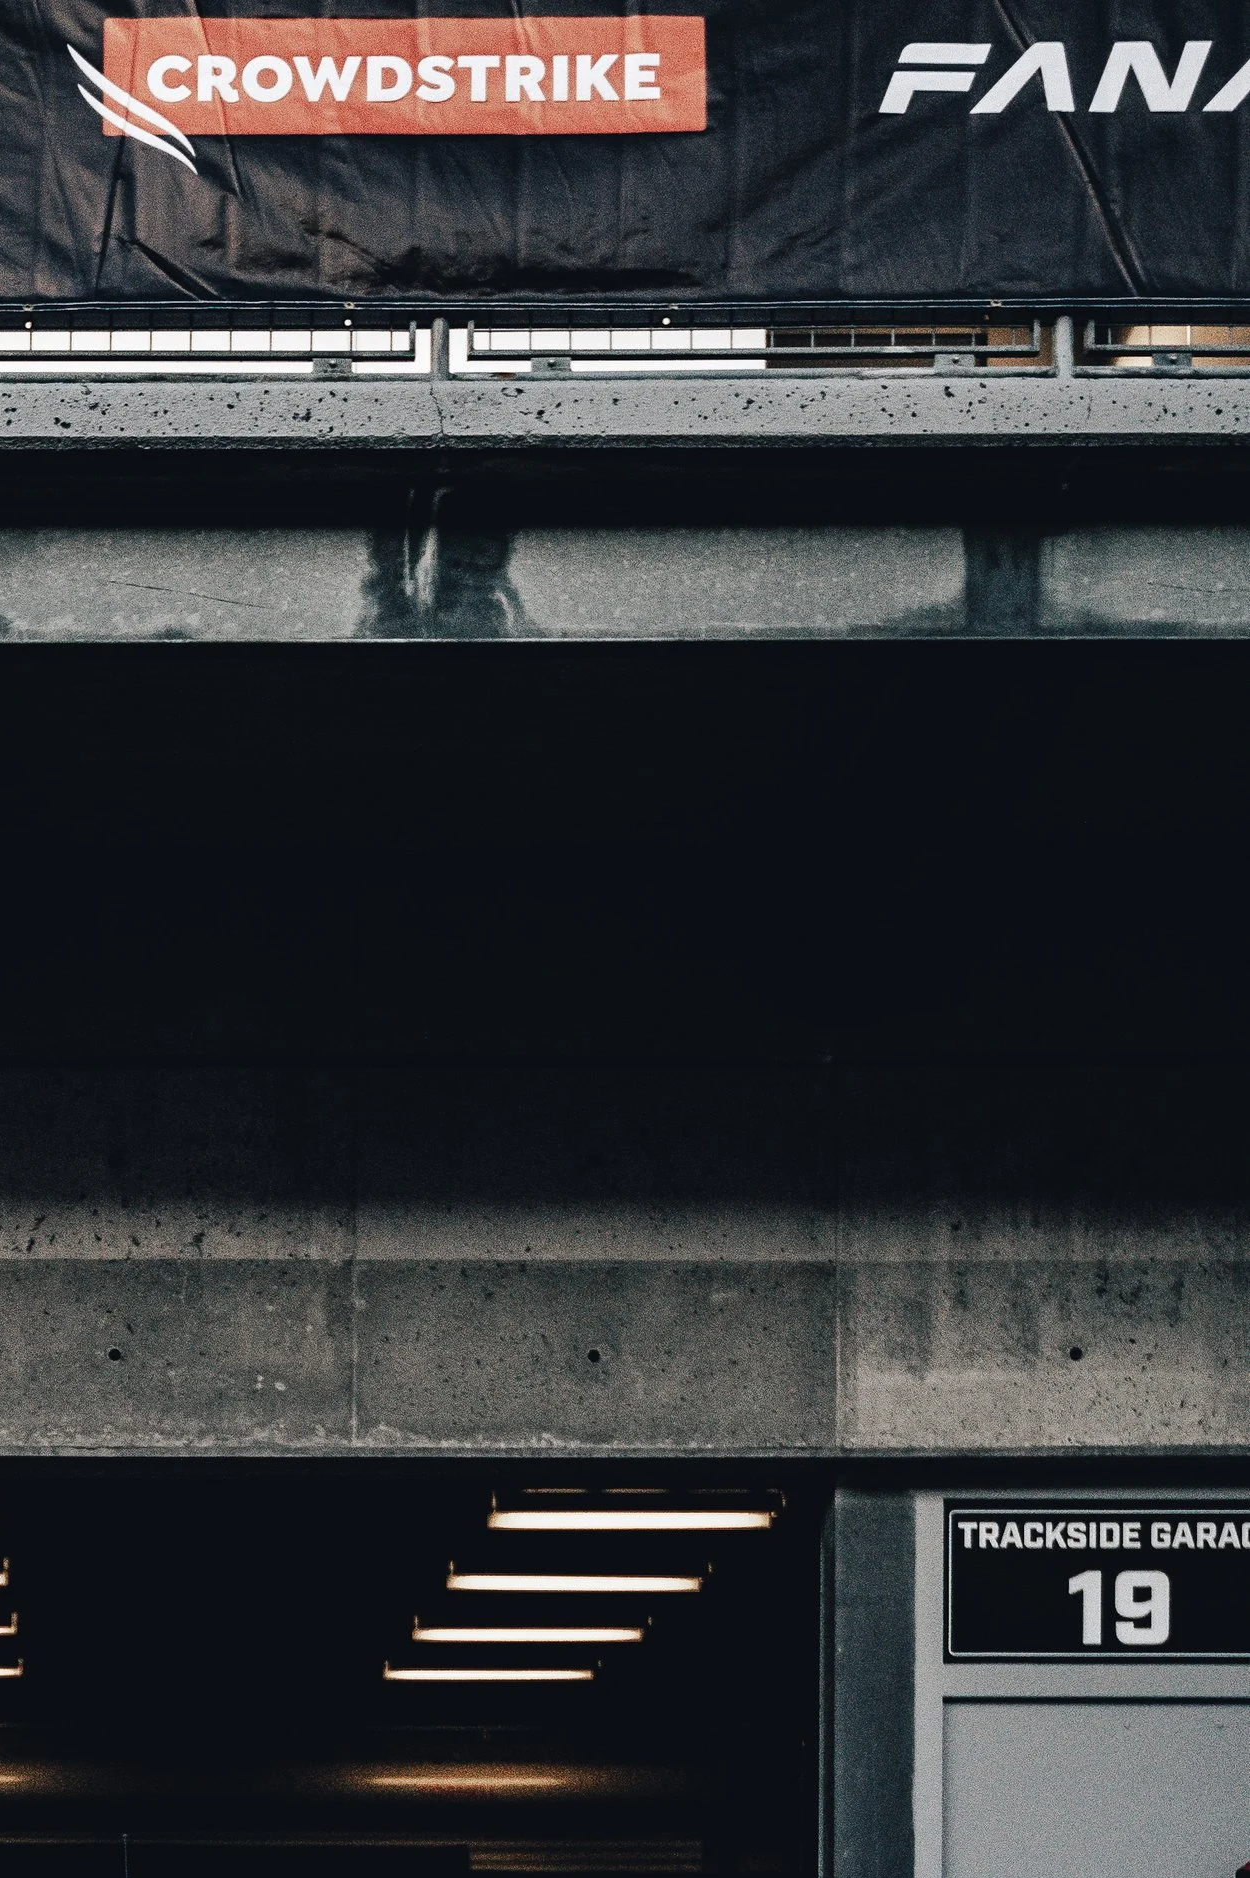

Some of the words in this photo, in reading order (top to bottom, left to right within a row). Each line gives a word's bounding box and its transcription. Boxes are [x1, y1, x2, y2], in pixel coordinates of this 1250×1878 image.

[146, 52, 662, 103] CROWDSTRIKE
[957, 1521, 1141, 1550] TRACKSIDE
[1067, 1569, 1171, 1646] 19
